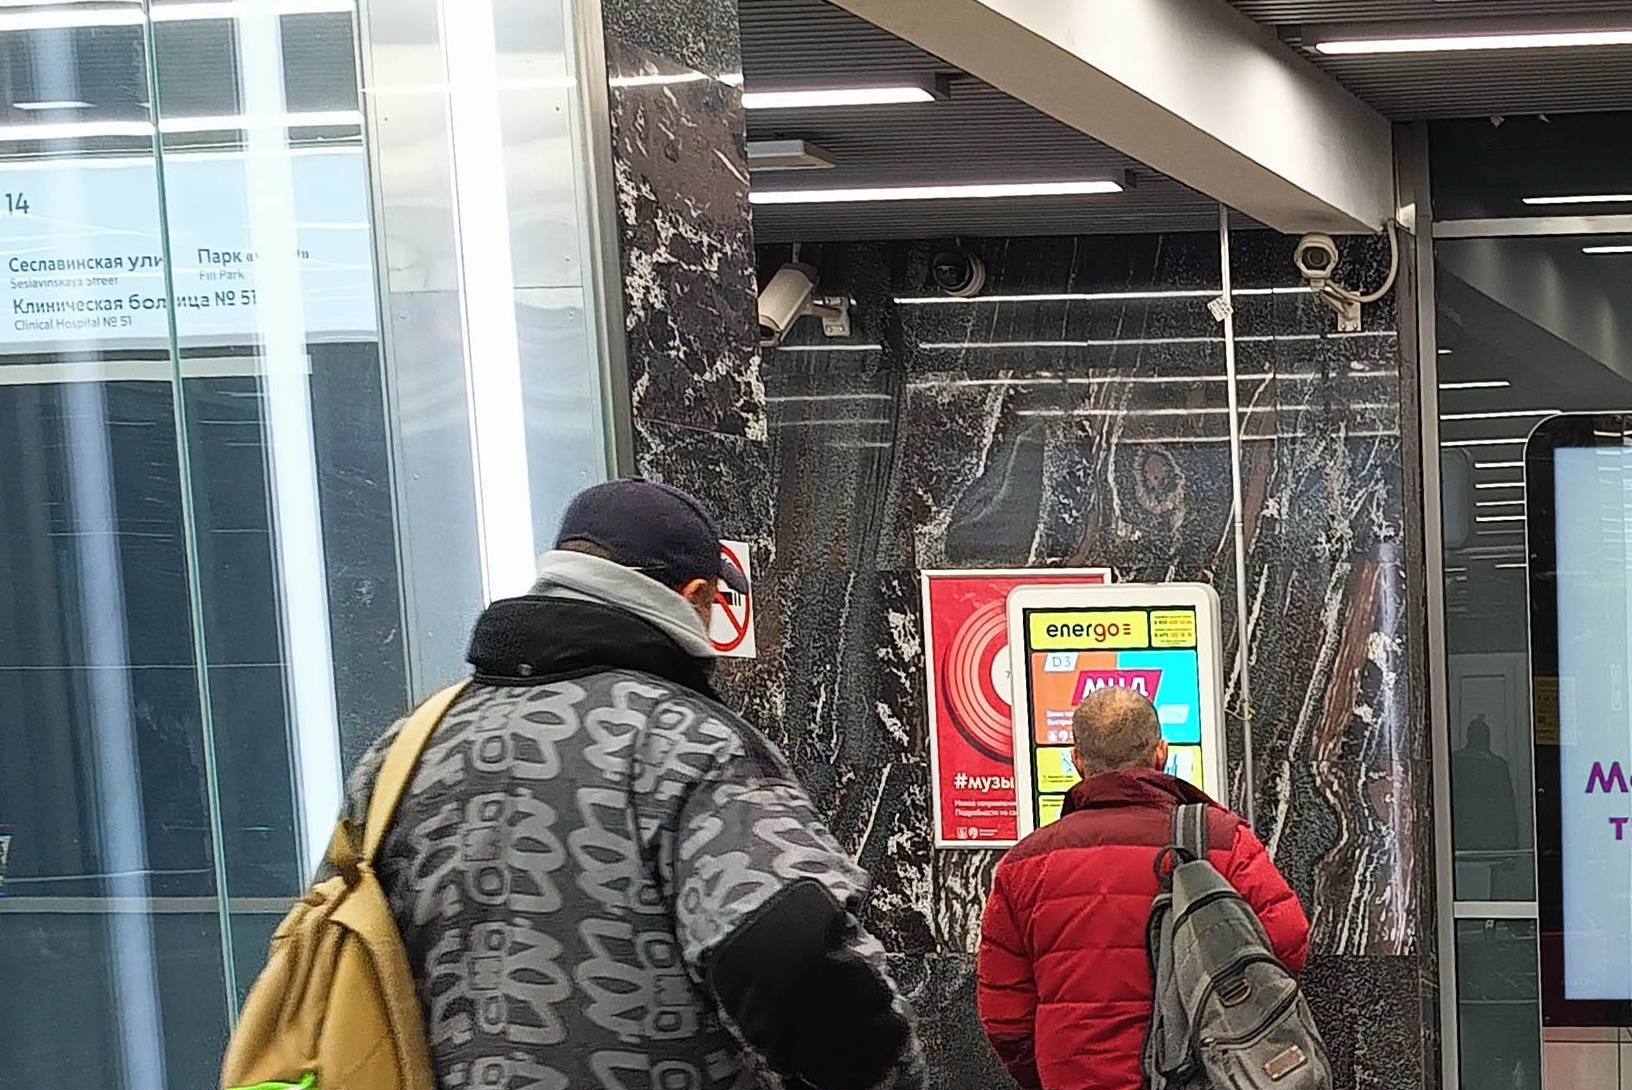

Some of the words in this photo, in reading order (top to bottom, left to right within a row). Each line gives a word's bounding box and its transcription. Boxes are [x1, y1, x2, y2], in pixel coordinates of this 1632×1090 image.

[5, 192, 30, 214] 14
[8, 257, 123, 272] Сеславинская
[127, 255, 164, 272] ули
[197, 248, 242, 266] Парк
[219, 270, 245, 281] Park
[13, 298, 123, 314] Клиническая
[128, 293, 210, 310] болица
[214, 291, 236, 307] №
[240, 289, 257, 306] 51
[14, 319, 54, 331] Clinical
[56, 317, 101, 330] Hospital
[120, 315, 133, 327] 51
[1046, 623, 1120, 643] energo
[954, 772, 1015, 793] #музы
